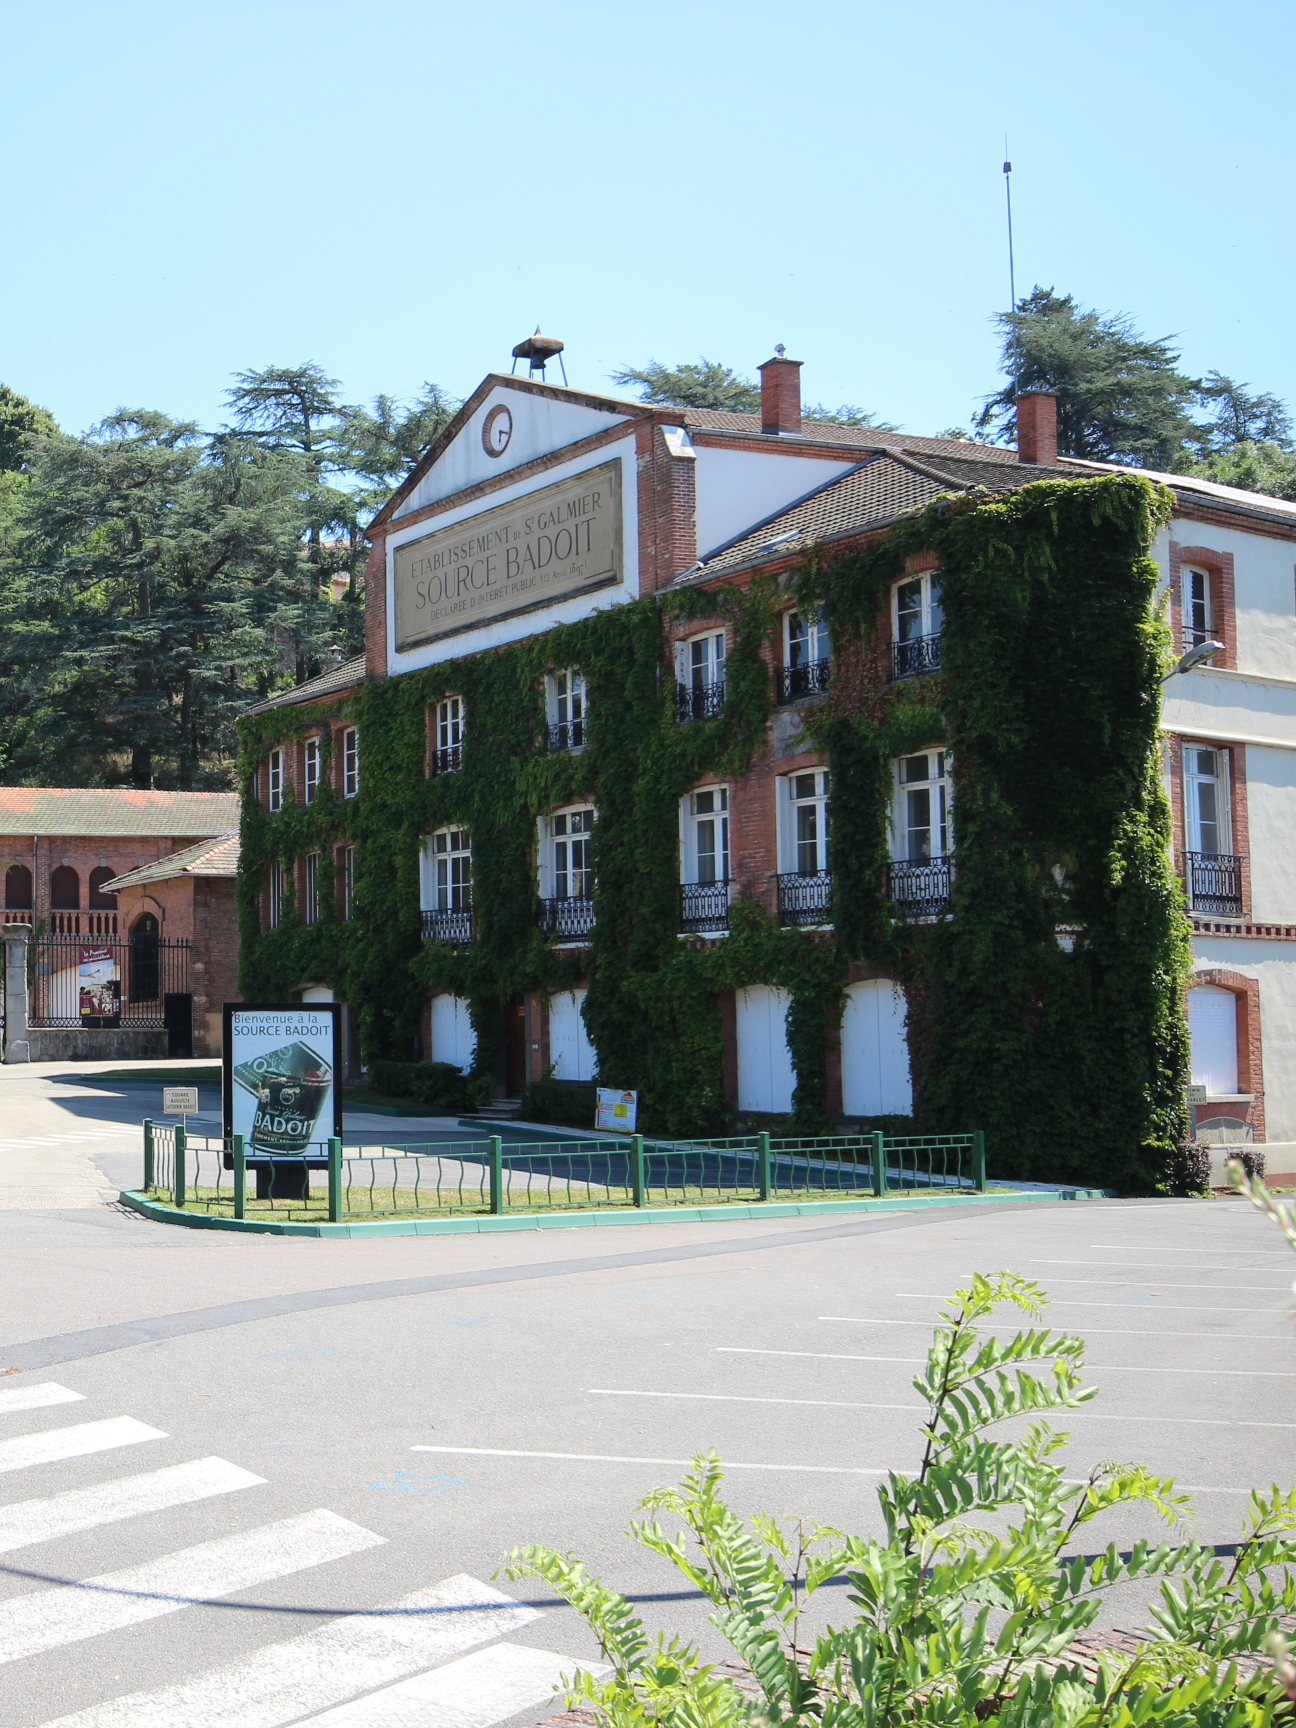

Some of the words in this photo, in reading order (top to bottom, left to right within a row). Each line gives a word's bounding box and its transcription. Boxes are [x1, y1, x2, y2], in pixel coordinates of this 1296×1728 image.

[411, 525, 511, 579] ÉTABLISSEMENT
[513, 530, 521, 541] DE
[537, 491, 602, 531] GALMIER
[415, 553, 498, 610] SOURCE
[506, 517, 596, 580] BADOIT
[511, 575, 537, 594] PUBLIC
[234, 1014, 294, 1024] Bienvenue
[298, 1013, 305, 1024] à
[307, 1013, 318, 1024] la
[234, 1026, 281, 1036] SOURCE
[285, 1026, 331, 1036] BADOIT
[254, 1110, 317, 1136] BADOIT
